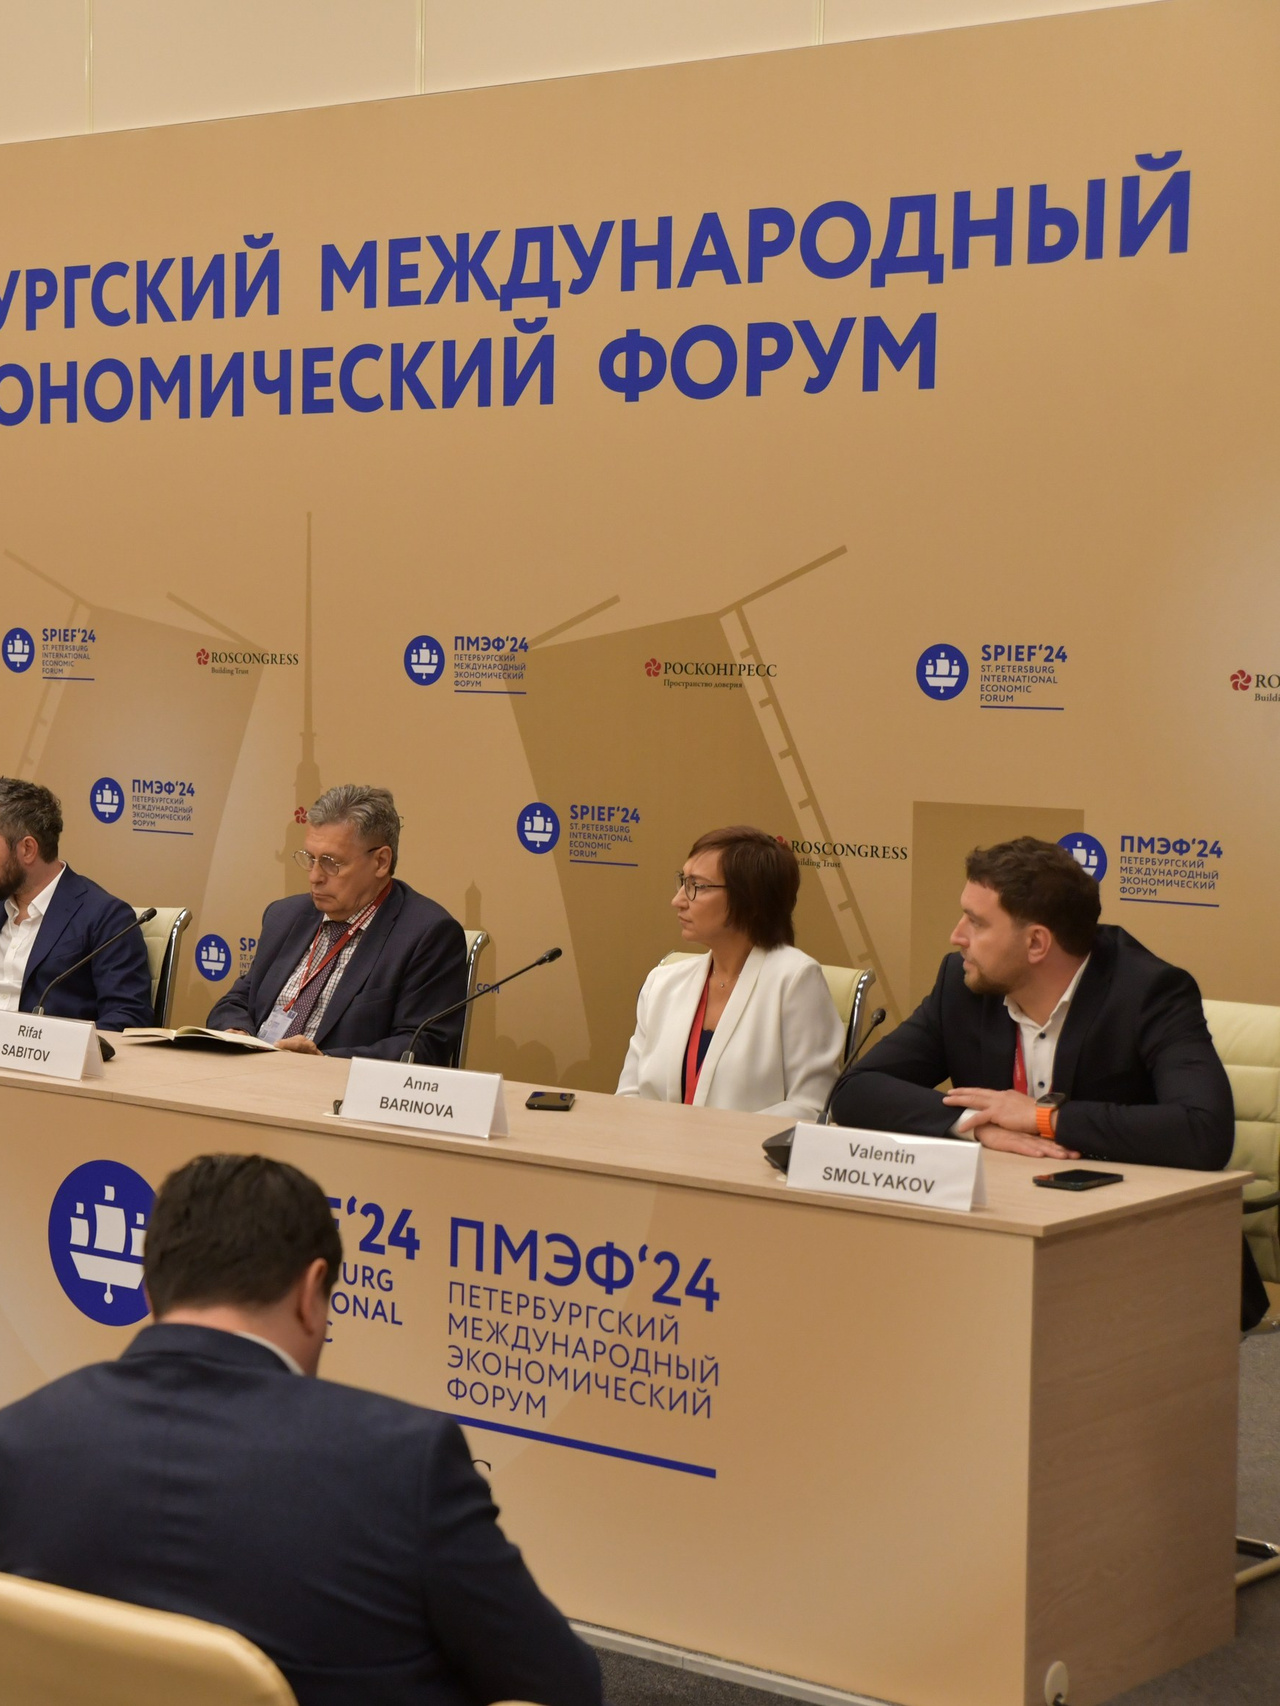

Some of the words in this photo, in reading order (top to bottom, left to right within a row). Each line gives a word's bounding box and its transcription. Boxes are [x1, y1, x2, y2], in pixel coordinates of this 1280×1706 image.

[322, 149, 1191, 312] МЕЖДУНАРОДНЫЙ
[598, 312, 937, 403] ФОРУМ
[51, 644, 89, 652] PETERSBURG
[981, 644, 1068, 663] SPIEF‘24
[42, 652, 91, 660] INTERNATIONAL
[211, 652, 299, 666] ROSCONGRESS
[454, 653, 516, 662] ПЕТЕРБУРГСКИЙ
[211, 667, 234, 676] Building
[454, 662, 526, 671] МЕЖДУНАРОДНЫЙ
[663, 662, 778, 678] РОСКОНГРЕСС
[981, 664, 993, 673] ST.
[995, 664, 1055, 674] PETERSBURG
[454, 671, 524, 680] ЭКОНОМИЧЕСКИЙ
[980, 674, 1058, 684] INTERNATIONAL
[664, 679, 712, 689] Пространство
[713, 681, 743, 691] доверия
[980, 684, 1032, 693] ECONOMIC
[980, 693, 1014, 702] FORUM
[132, 795, 184, 805] ПЕТЕРБУРГСКИЙ
[132, 803, 193, 814] МЕЖДУНАРОДНЫЙ
[132, 811, 191, 821] ЭКОНОМИЧЕСКИЙ
[132, 819, 156, 827] ФОРУМ
[570, 822, 580, 830] ST.
[581, 823, 630, 834] PETERSBURG
[569, 832, 633, 843] INTERNATIONAL
[569, 840, 612, 850] ECONOMIC
[791, 840, 908, 861] ROSCONGRESS
[1120, 835, 1223, 859] ПМЭФ‘24
[569, 849, 597, 858] FORUM
[798, 859, 821, 870] ilding
[822, 859, 841, 868] Trust
[1120, 856, 1204, 869] ПЕТЕРБУРГСКИЙ
[1120, 866, 1219, 880] МЕЖДУНАРОДНЫЙ
[1120, 876, 1216, 890] ЭКОНОМИЧЕСКИЙ
[1120, 886, 1157, 897] ФОРУМ
[17, 1024, 43, 1039] Rifat
[1, 1043, 50, 1062] SABITOV
[403, 1076, 439, 1093] Anna
[379, 1096, 454, 1119] BARINOVA
[849, 1143, 915, 1165] Valentin
[822, 1166, 935, 1194] SMOLYAKOV
[450, 1216, 720, 1312] ПМЭФ‘24
[449, 1281, 679, 1345] ПЕТЕРБУРГСКИЙ
[448, 1312, 719, 1387] МЕЖДУНАРОДНЫЙ
[447, 1344, 711, 1419] ЭКОНОМИЧЕСКИЙ
[447, 1377, 546, 1418] ФОРУМ
